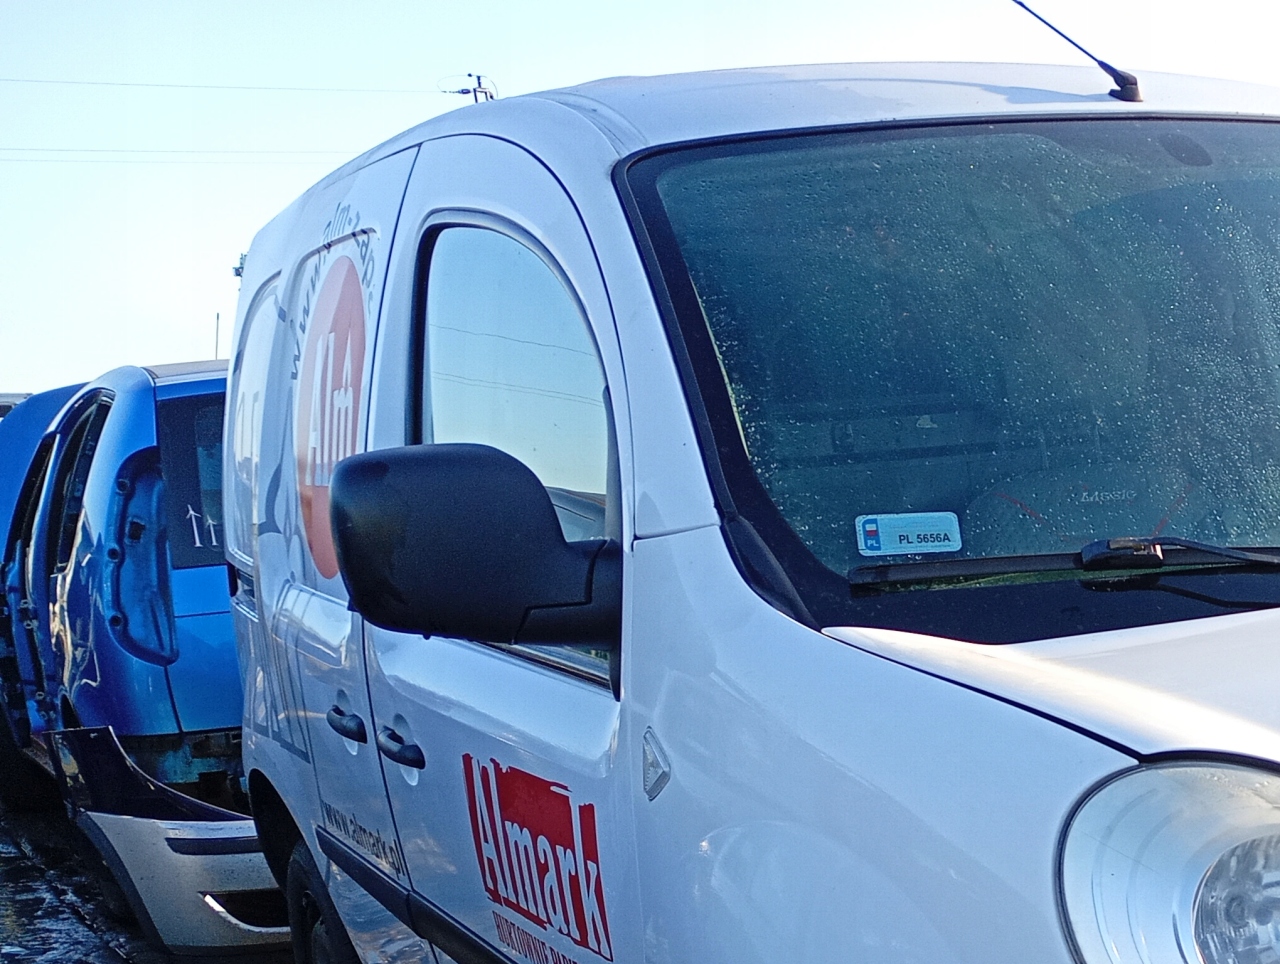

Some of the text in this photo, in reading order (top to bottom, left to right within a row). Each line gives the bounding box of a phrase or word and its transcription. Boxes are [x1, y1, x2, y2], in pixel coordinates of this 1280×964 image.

[867, 539, 880, 548] PL
[898, 533, 951, 544] PL 5656A
[320, 799, 405, 880] www.almark.pl
[463, 753, 614, 962] Almark
